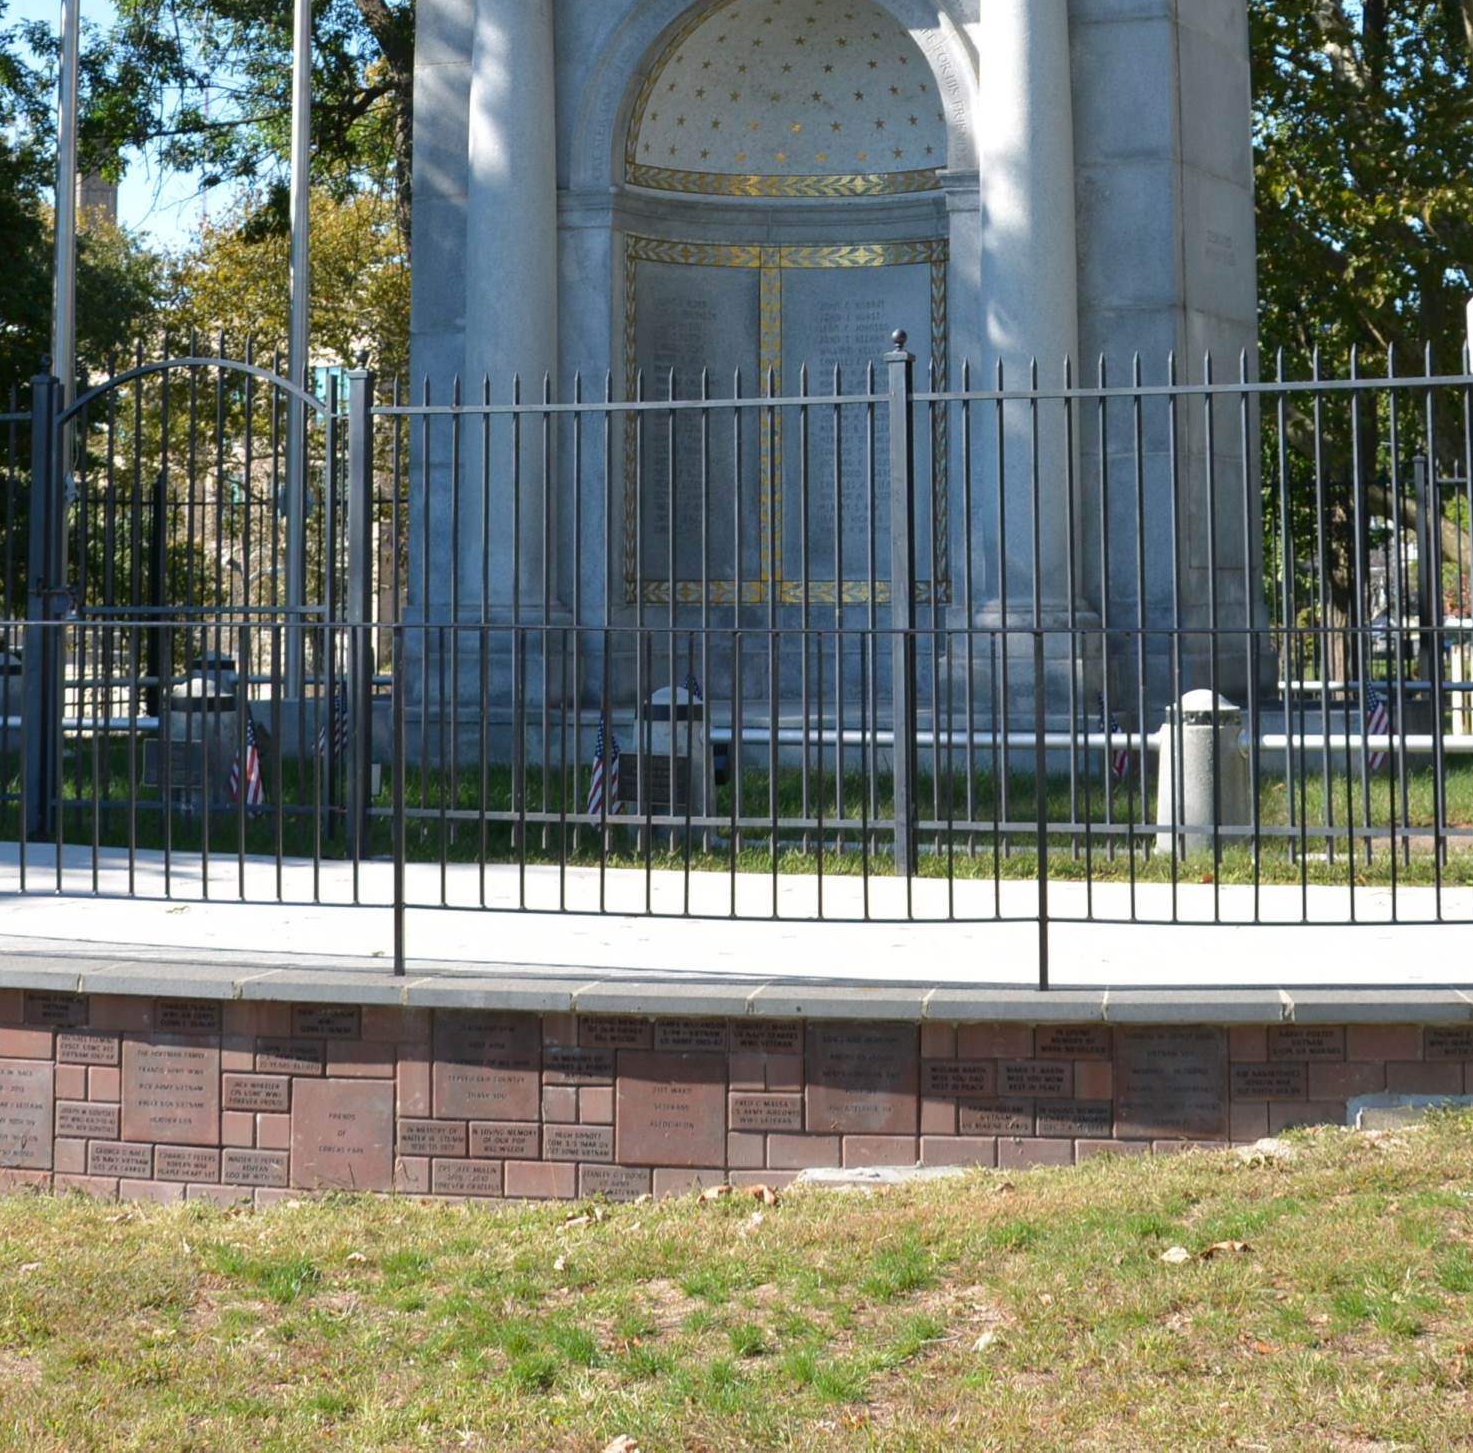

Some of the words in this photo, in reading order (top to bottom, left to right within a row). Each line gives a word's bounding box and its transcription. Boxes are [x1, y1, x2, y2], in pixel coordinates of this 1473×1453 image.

[494, 1075, 525, 1083] COUNTRY
[961, 1083, 984, 1091] PEACE
[467, 1092, 490, 1100] THANK
[337, 1129, 345, 1137] OF
